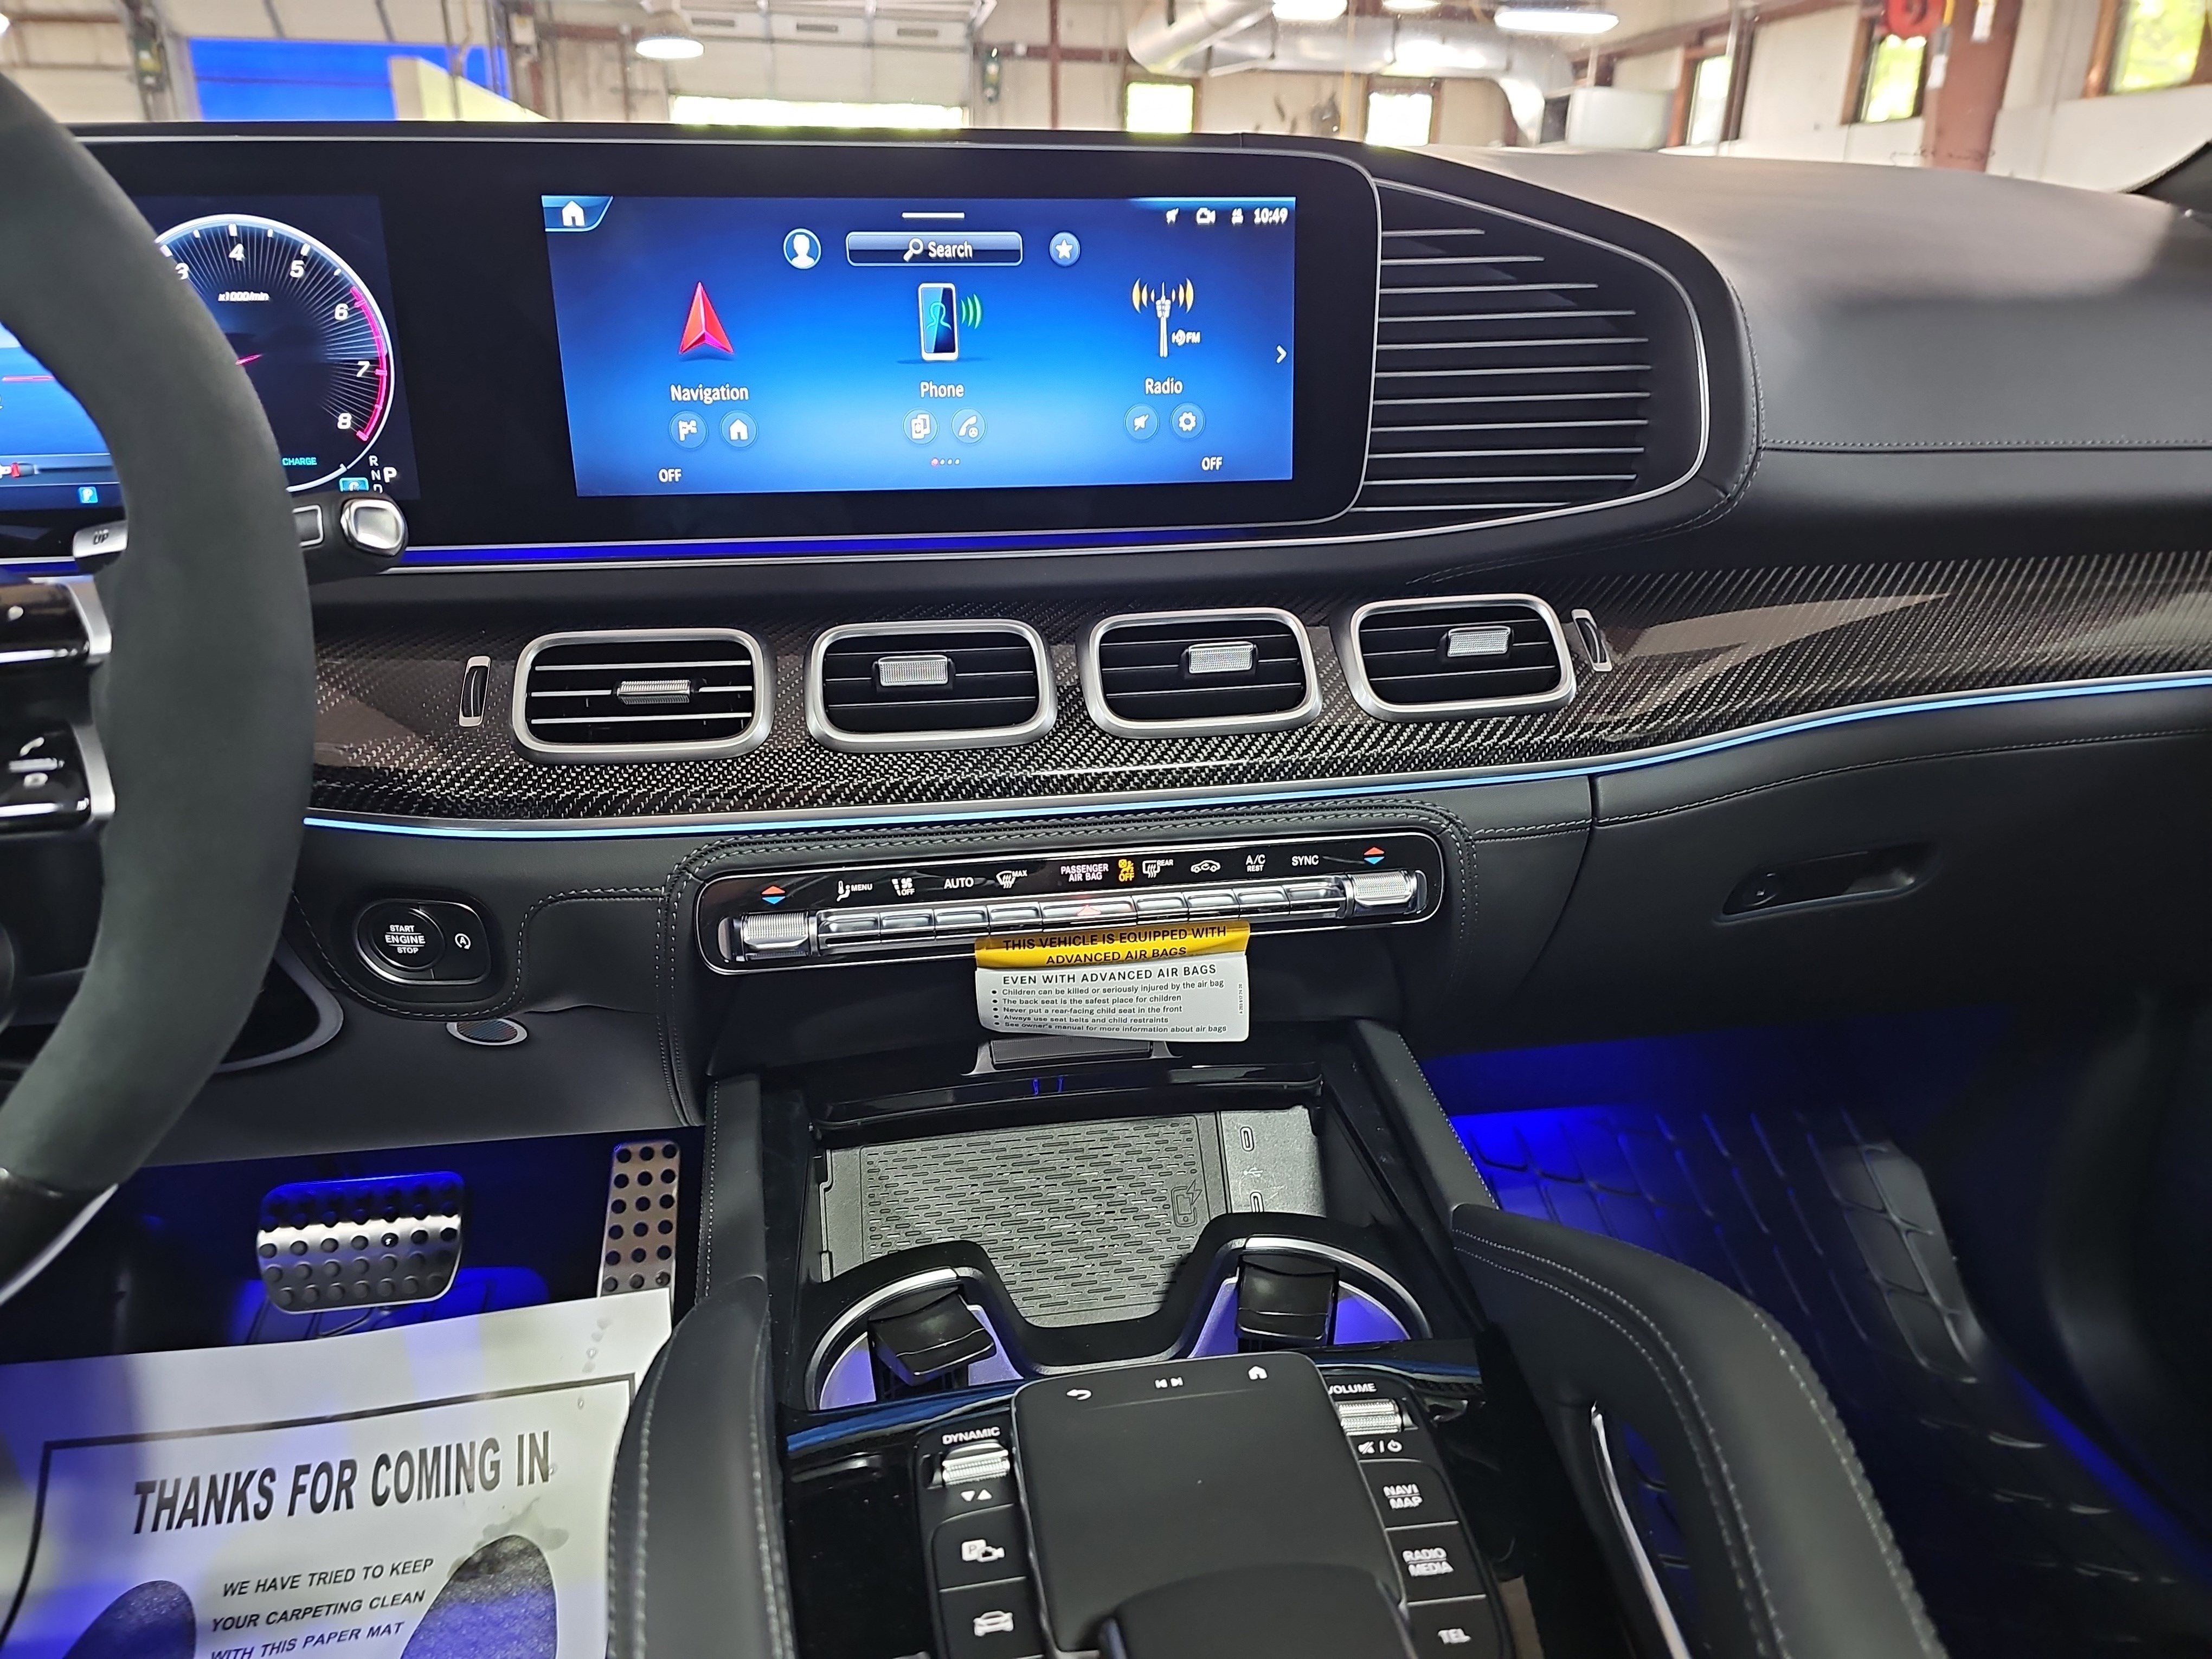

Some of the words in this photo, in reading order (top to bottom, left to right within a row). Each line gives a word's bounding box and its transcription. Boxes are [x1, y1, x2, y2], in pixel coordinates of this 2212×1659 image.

[1254, 208, 1288, 224] 10:49
[229, 244, 245, 261] 4
[928, 241, 973, 259] Search
[175, 263, 189, 280] 3
[290, 260, 305, 278] 5
[335, 303, 348, 320] 6
[356, 361, 370, 377] 7
[670, 383, 749, 404] Navigation
[920, 381, 964, 398] Phone
[1144, 377, 1182, 395] Radio
[337, 413, 352, 429] 8
[282, 457, 317, 465] CHARGE
[369, 455, 378, 466] R
[1201, 456, 1223, 471] OFF
[371, 470, 381, 480] N
[383, 467, 397, 483] P
[658, 468, 681, 483] OFF
[1246, 854, 1265, 865] A/C
[1292, 855, 1319, 866] SYNC
[1060, 863, 1109, 874] PASSENGER
[944, 877, 974, 889] AUTO
[1069, 873, 1083, 882] AIR
[1085, 872, 1103, 881] BAG
[1118, 873, 1135, 882] OFF
[385, 935, 426, 944] ENGINE
[1003, 938, 1036, 950] THIS
[1039, 935, 1097, 948] VEHICLE
[1103, 934, 1115, 944] IS
[1120, 929, 1187, 943] EQUIPPED
[1192, 926, 1226, 938] WITH
[1046, 952, 1121, 964] ADVANCED
[1125, 950, 1147, 960] AIR
[1152, 947, 1186, 957] BAGS
[1004, 975, 1036, 984] EVEN
[1042, 974, 1075, 983] WITH
[1081, 969, 1152, 982] ADVANCED
[1158, 968, 1178, 978] AIR
[1184, 964, 1216, 976] BAGS
[1102, 986, 1139, 994] seriously
[1141, 983, 1168, 993] injured
[1171, 982, 1180, 991] by
[1210, 980, 1224, 988] bag
[1112, 996, 1133, 1005] place
[1149, 994, 1181, 1002] children
[942, 1426, 1000, 1445] DYNAMIC
[134, 1467, 276, 1534] THANKS
[287, 1459, 357, 1517] FOR
[371, 1438, 501, 1507] COMING
[516, 1431, 551, 1487] IN
[1383, 1484, 1419, 1496] NAVI
[1390, 1496, 1423, 1509] MAP
[1403, 1547, 1446, 1563] RADIO
[1408, 1561, 1454, 1577] MEDIA
[223, 1580, 250, 1597] WE
[254, 1574, 301, 1593] HAVE
[308, 1568, 356, 1587] TRIED
[363, 1564, 384, 1580] TO
[389, 1558, 434, 1577] KEEP
[212, 1613, 260, 1632] YOUR
[266, 1599, 363, 1625] CARPETING
[369, 1590, 426, 1610] CLEAN
[260, 1638, 298, 1658] THIS
[302, 1628, 362, 1649] PAPER
[366, 1622, 406, 1639] MAT
[1438, 1628, 1471, 1644] TEL
